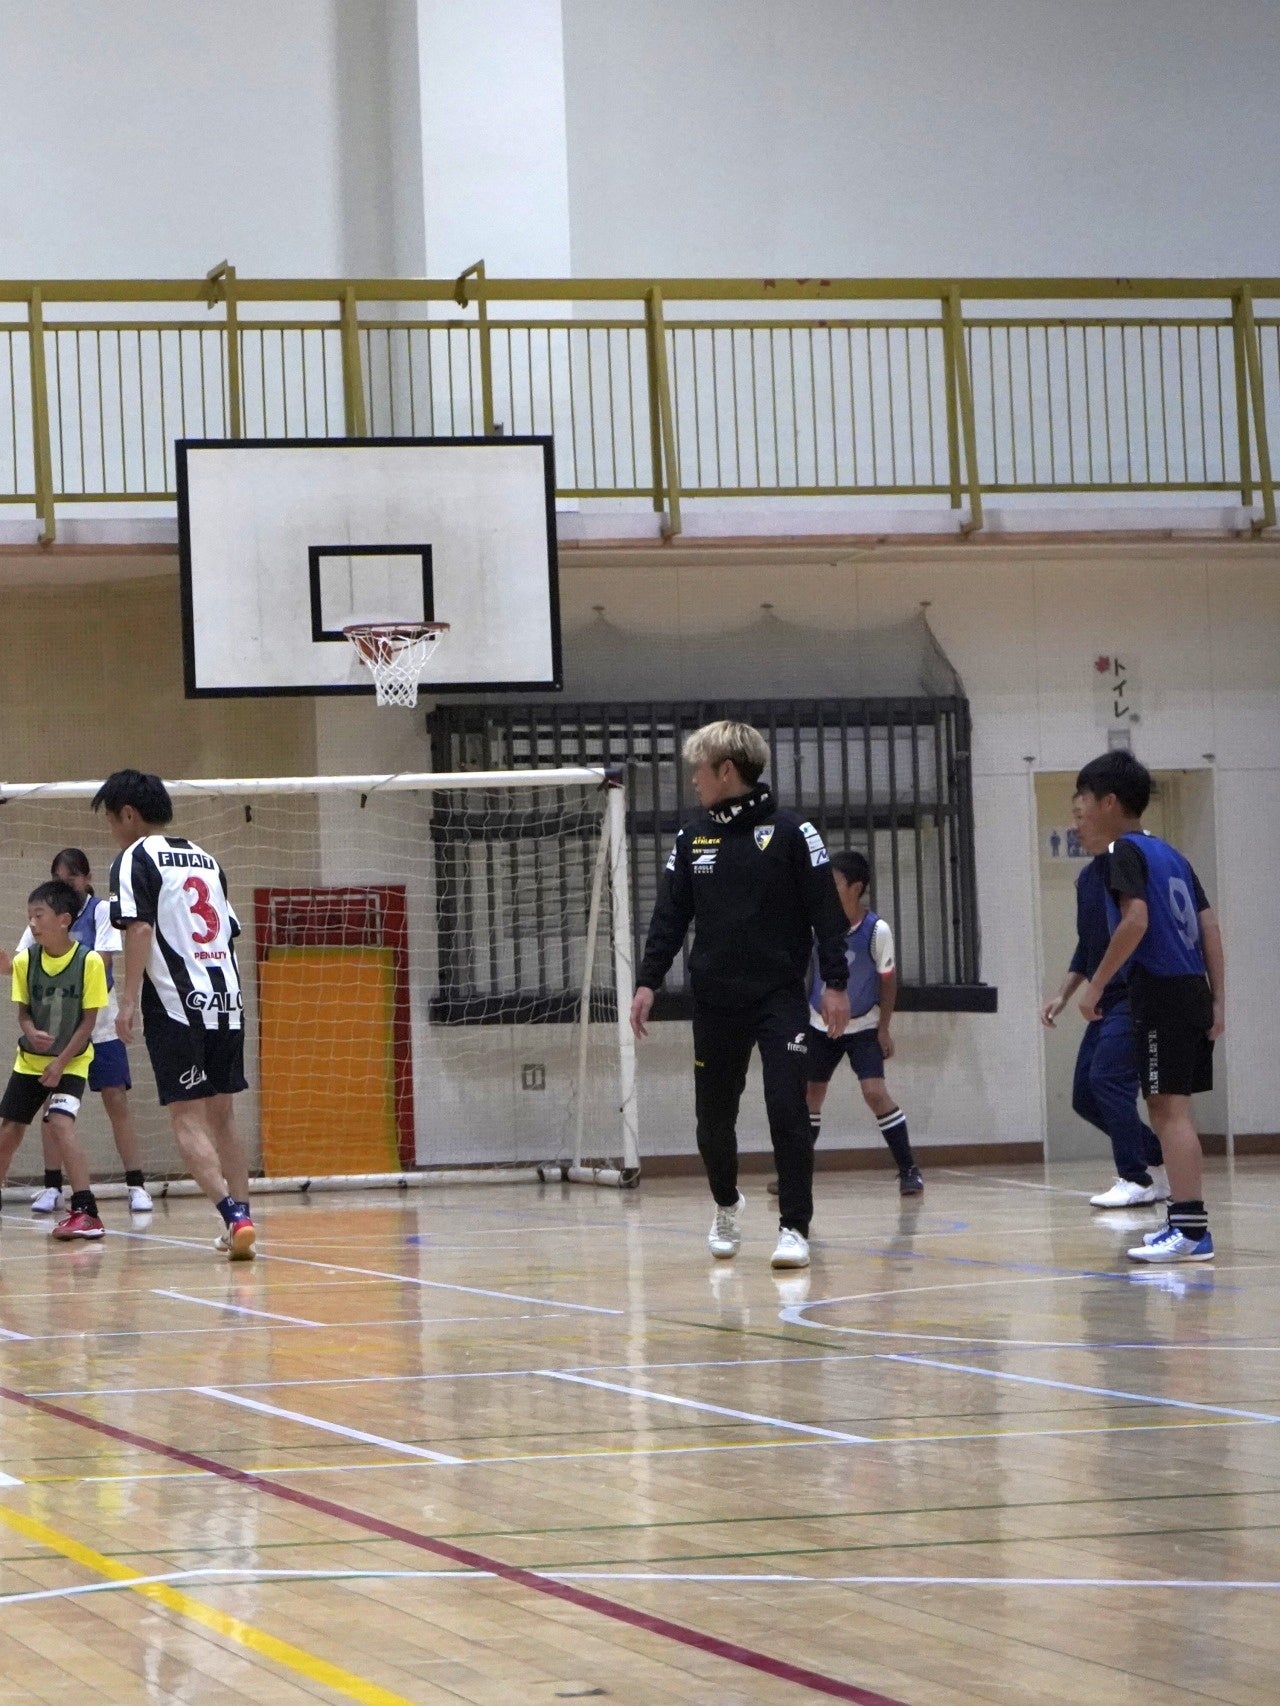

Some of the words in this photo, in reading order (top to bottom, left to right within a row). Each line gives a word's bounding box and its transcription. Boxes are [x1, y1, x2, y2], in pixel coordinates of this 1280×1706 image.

[1112, 657, 1130, 718] トイレ
[159, 852, 213, 869] FIAT
[182, 876, 221, 944] 3
[1168, 876, 1199, 950] 9
